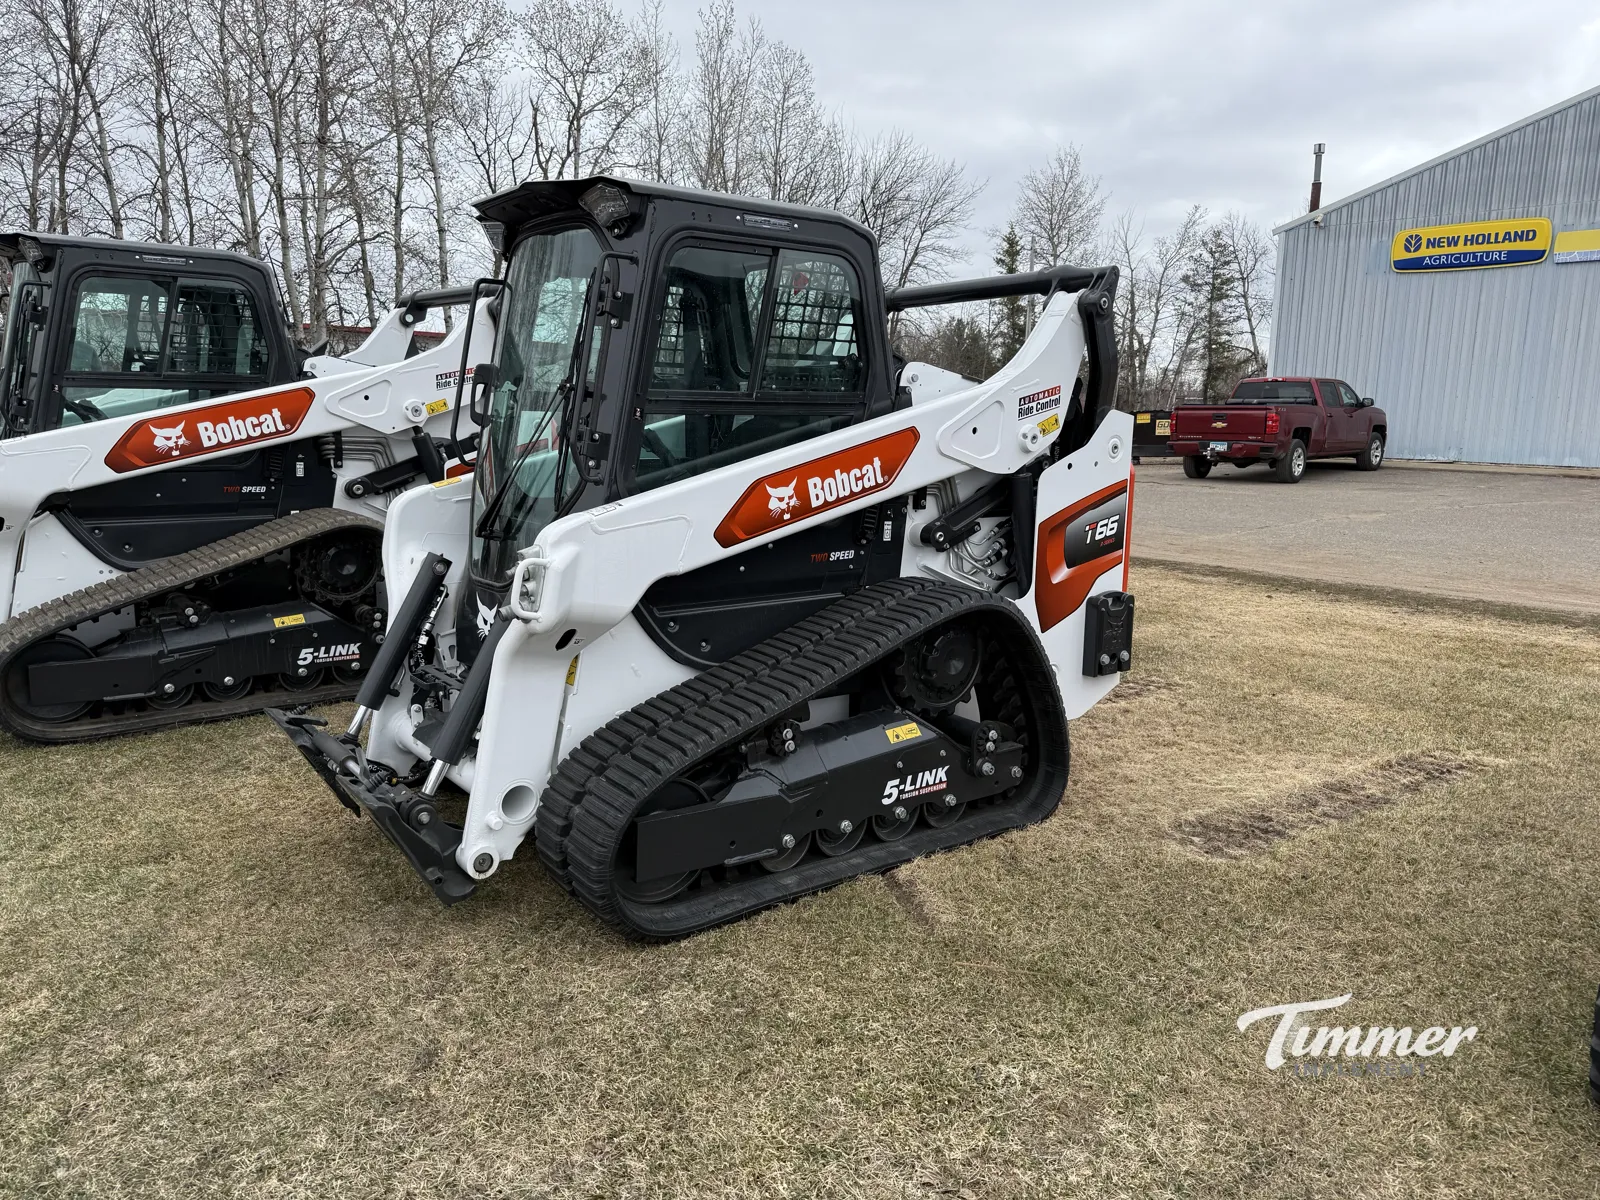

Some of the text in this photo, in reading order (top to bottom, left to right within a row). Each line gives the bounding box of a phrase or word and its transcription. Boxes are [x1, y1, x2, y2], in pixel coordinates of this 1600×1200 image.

[1425, 229, 1538, 250] NEW HOLLAND
[1422, 251, 1508, 266] AGRICULTURE
[436, 380, 452, 389] Ride
[437, 368, 476, 381] AUTOMTIC
[1020, 386, 1060, 405] AUTOMATIC
[1018, 395, 1061, 418] Ride Control
[196, 408, 285, 448] Bobcat
[806, 456, 884, 508] Bobcat
[1085, 514, 1120, 544] T66
[810, 550, 855, 562] TWO SPEED
[296, 642, 362, 666] 5-LINK
[333, 654, 360, 662] SUSPENSION
[881, 765, 951, 806] 5-LINK
[899, 783, 947, 800] TORSION SUSPENSION
